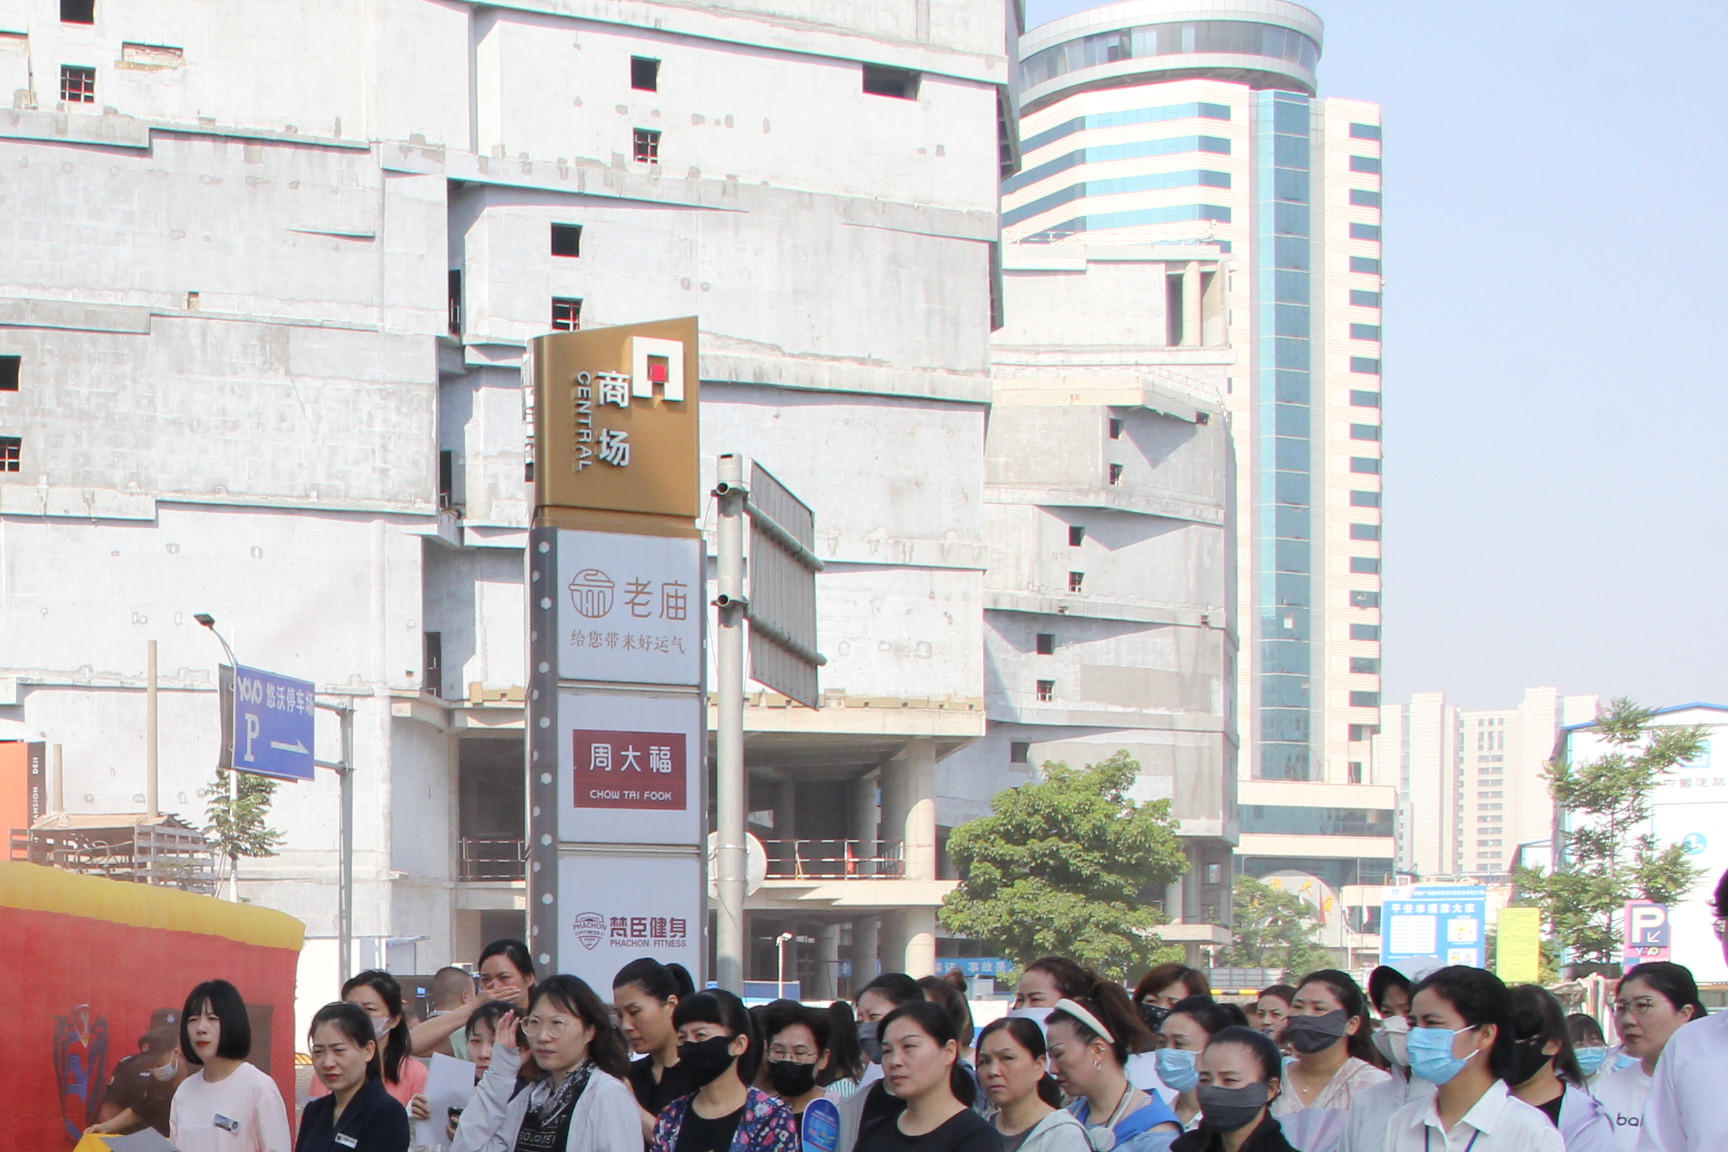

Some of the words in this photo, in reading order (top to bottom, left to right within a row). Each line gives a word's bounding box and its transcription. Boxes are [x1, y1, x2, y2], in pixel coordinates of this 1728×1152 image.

[576, 371, 593, 472] CENTRAL
[597, 370, 630, 467] 商场
[624, 577, 688, 621] 老庙
[570, 630, 686, 654] 给您带来好运气
[244, 713, 260, 762] P
[589, 743, 672, 773] 周大福
[589, 790, 620, 800] CHOW
[623, 791, 640, 800] TAI
[644, 791, 672, 801] FOOK
[610, 917, 687, 938] 梵臣健身
[1632, 907, 1665, 942] P
[610, 939, 650, 947] PHACHON
[654, 939, 687, 948] FITNESS
